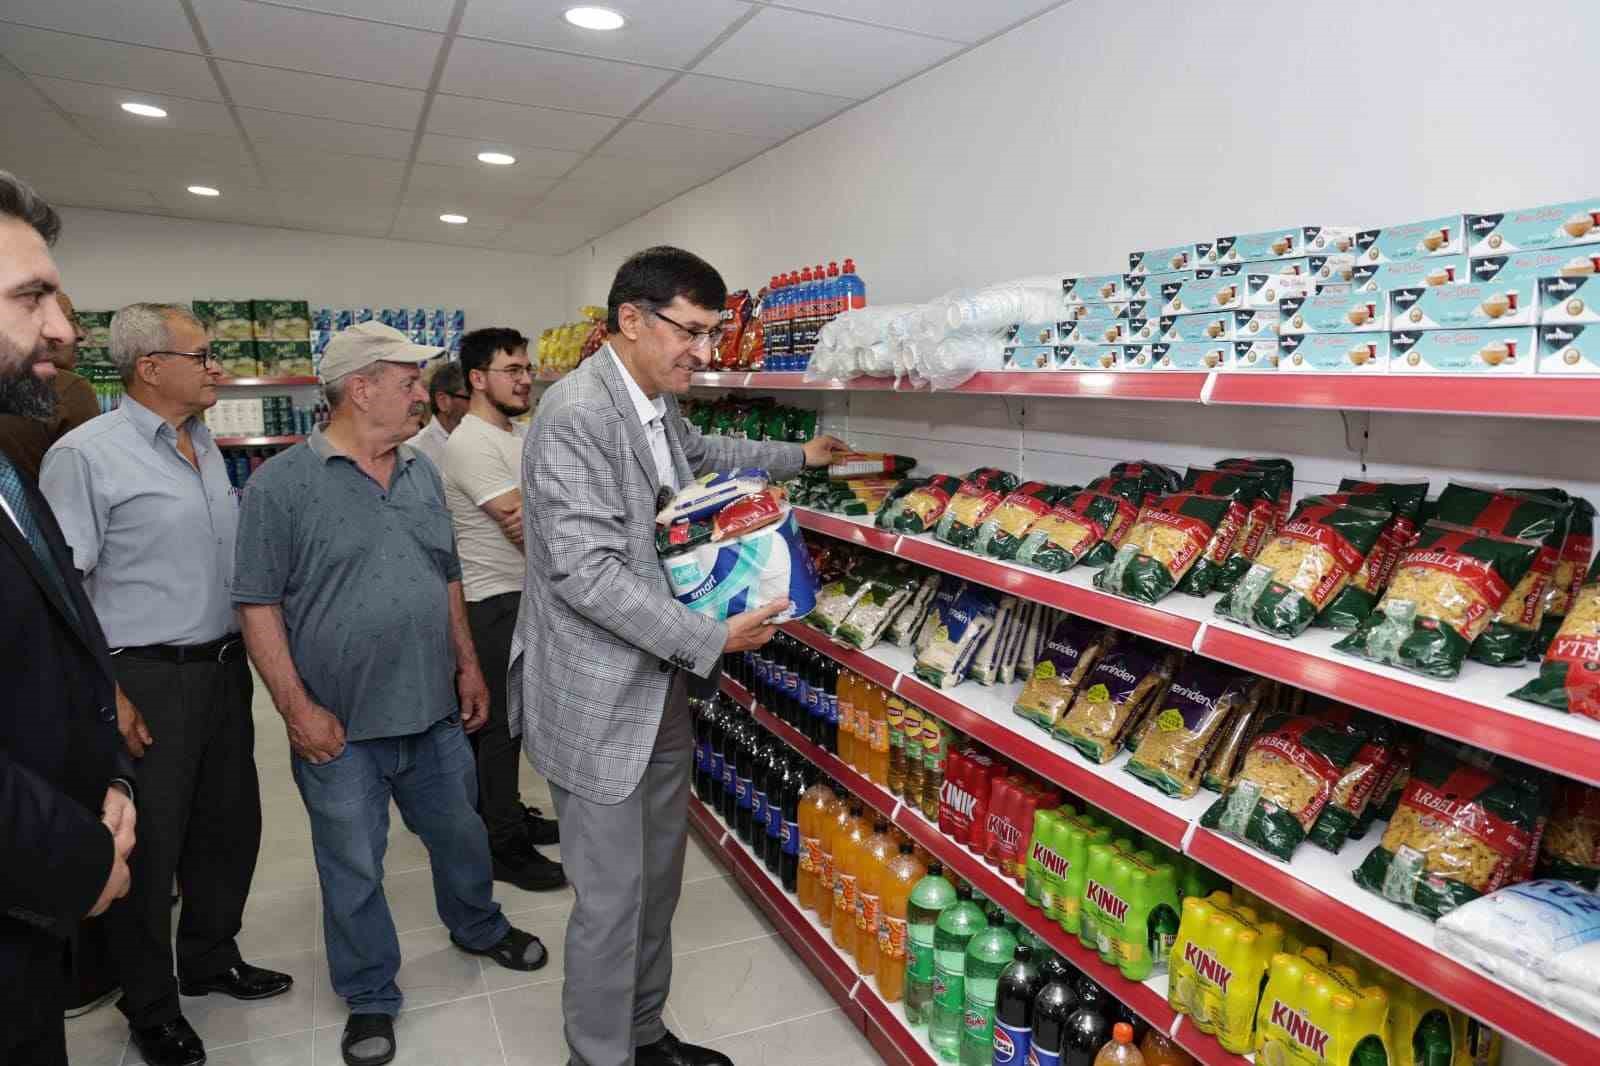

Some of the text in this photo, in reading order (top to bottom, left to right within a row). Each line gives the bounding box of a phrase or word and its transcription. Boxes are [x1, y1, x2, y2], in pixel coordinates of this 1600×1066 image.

[691, 575, 717, 600] smart
[1048, 641, 1079, 659] erinden
[986, 812, 1022, 846] KINIK
[1032, 840, 1071, 880] KINIK
[1085, 879, 1130, 926] KINIK
[1183, 941, 1233, 995] KINIK
[1270, 999, 1330, 1059] KINIK
